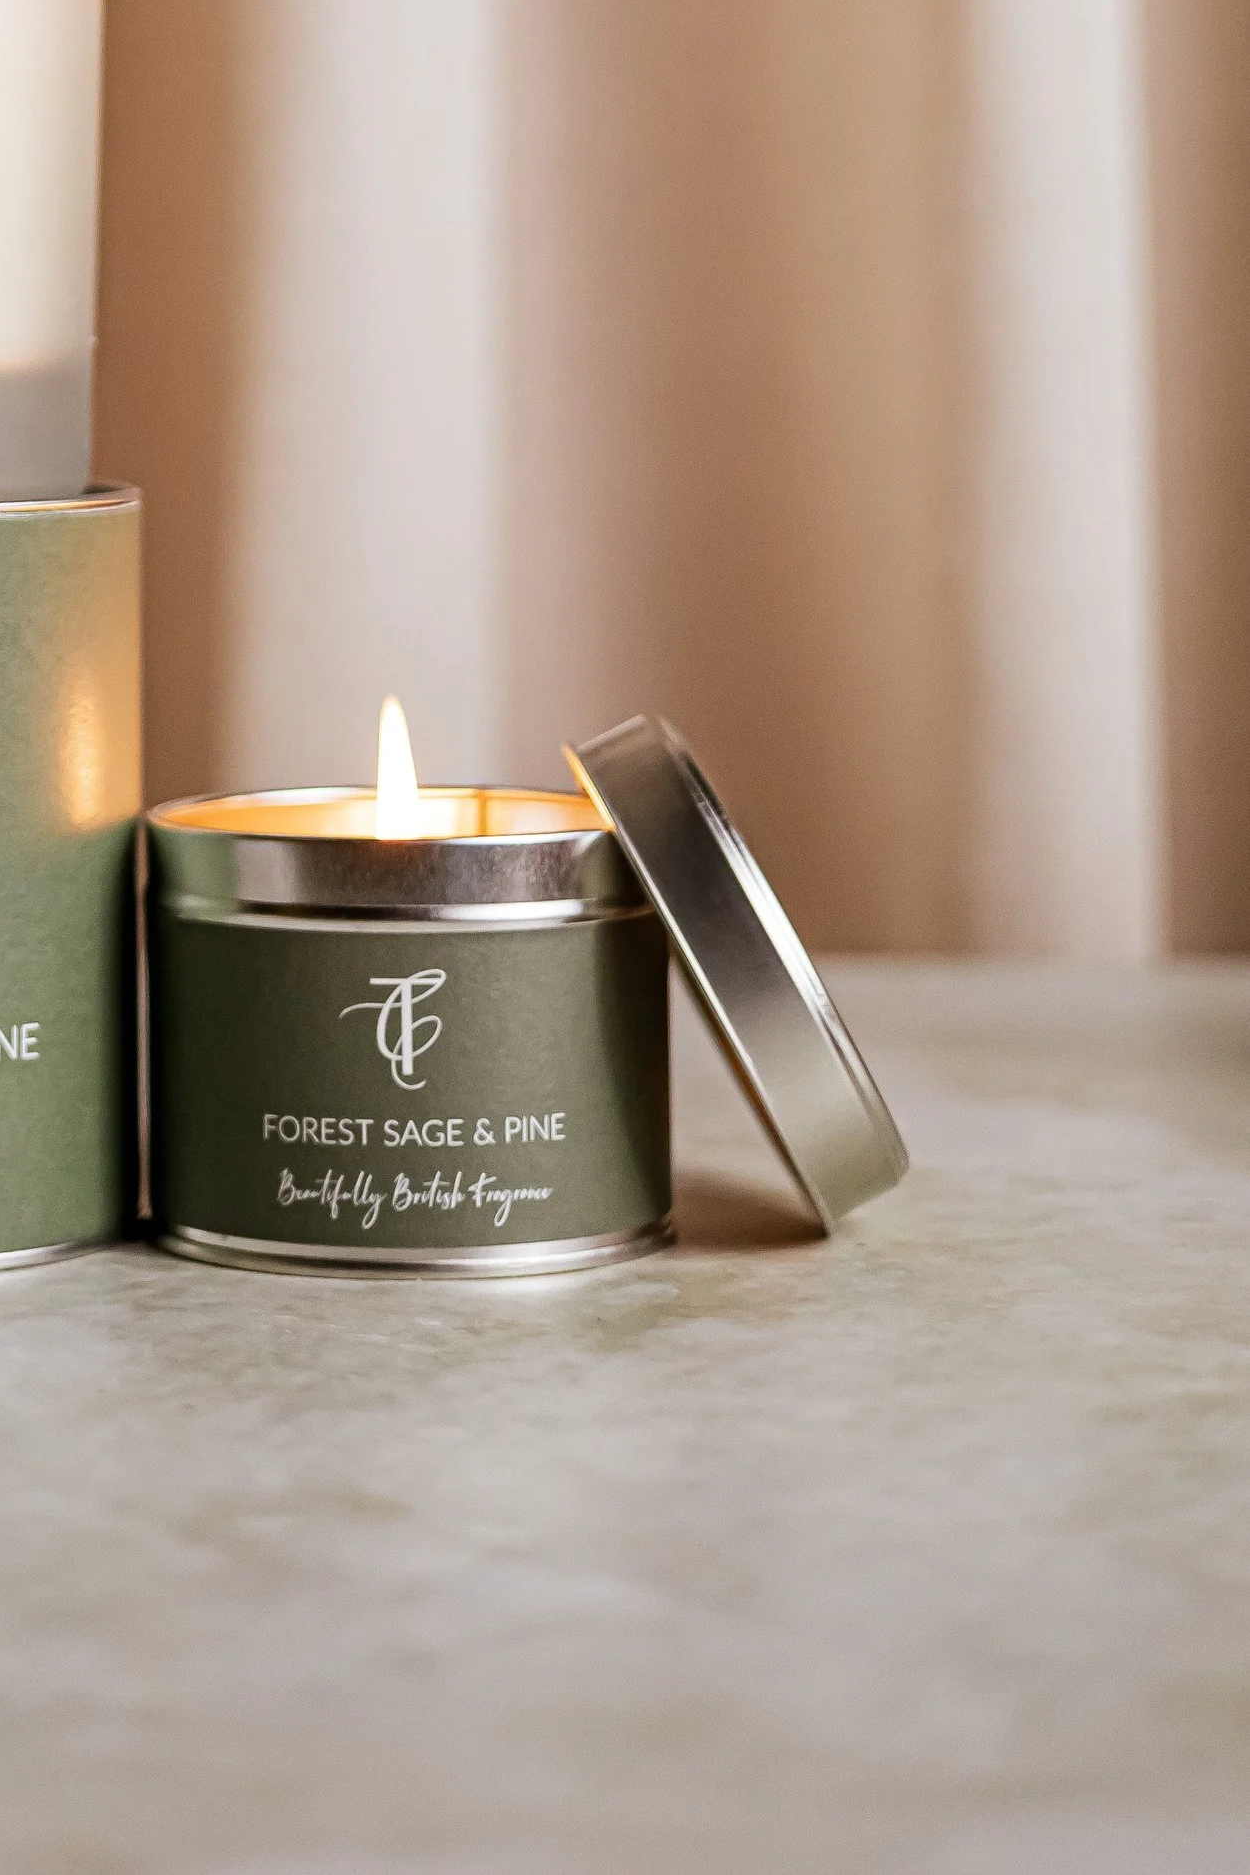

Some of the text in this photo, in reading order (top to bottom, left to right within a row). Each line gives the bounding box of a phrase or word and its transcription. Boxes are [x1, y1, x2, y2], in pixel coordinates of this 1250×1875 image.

[262, 1111, 567, 1147] FOREST SAGE & PINE
[391, 1170, 465, 1212] British
